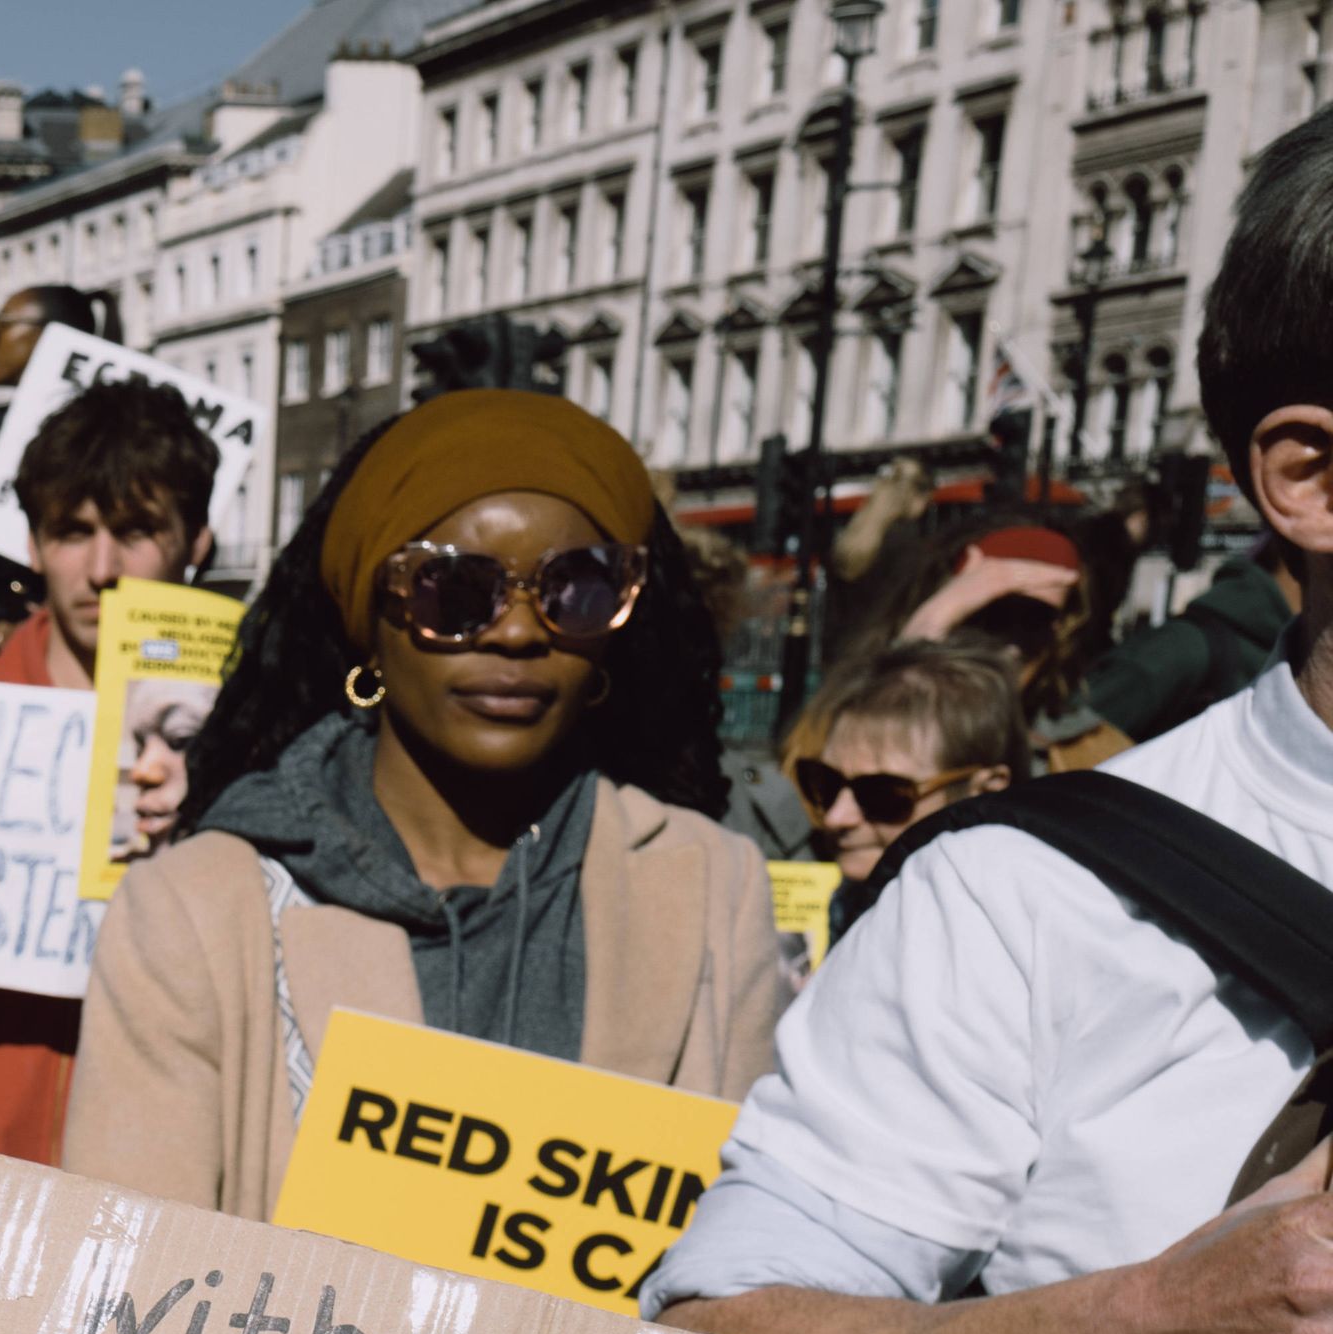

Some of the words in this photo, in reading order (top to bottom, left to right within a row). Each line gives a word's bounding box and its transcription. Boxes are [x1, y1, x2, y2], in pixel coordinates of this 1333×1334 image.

[60, 351, 254, 446] ECMA
[336, 1086, 512, 1178] RED
[470, 1202, 552, 1271] IS
